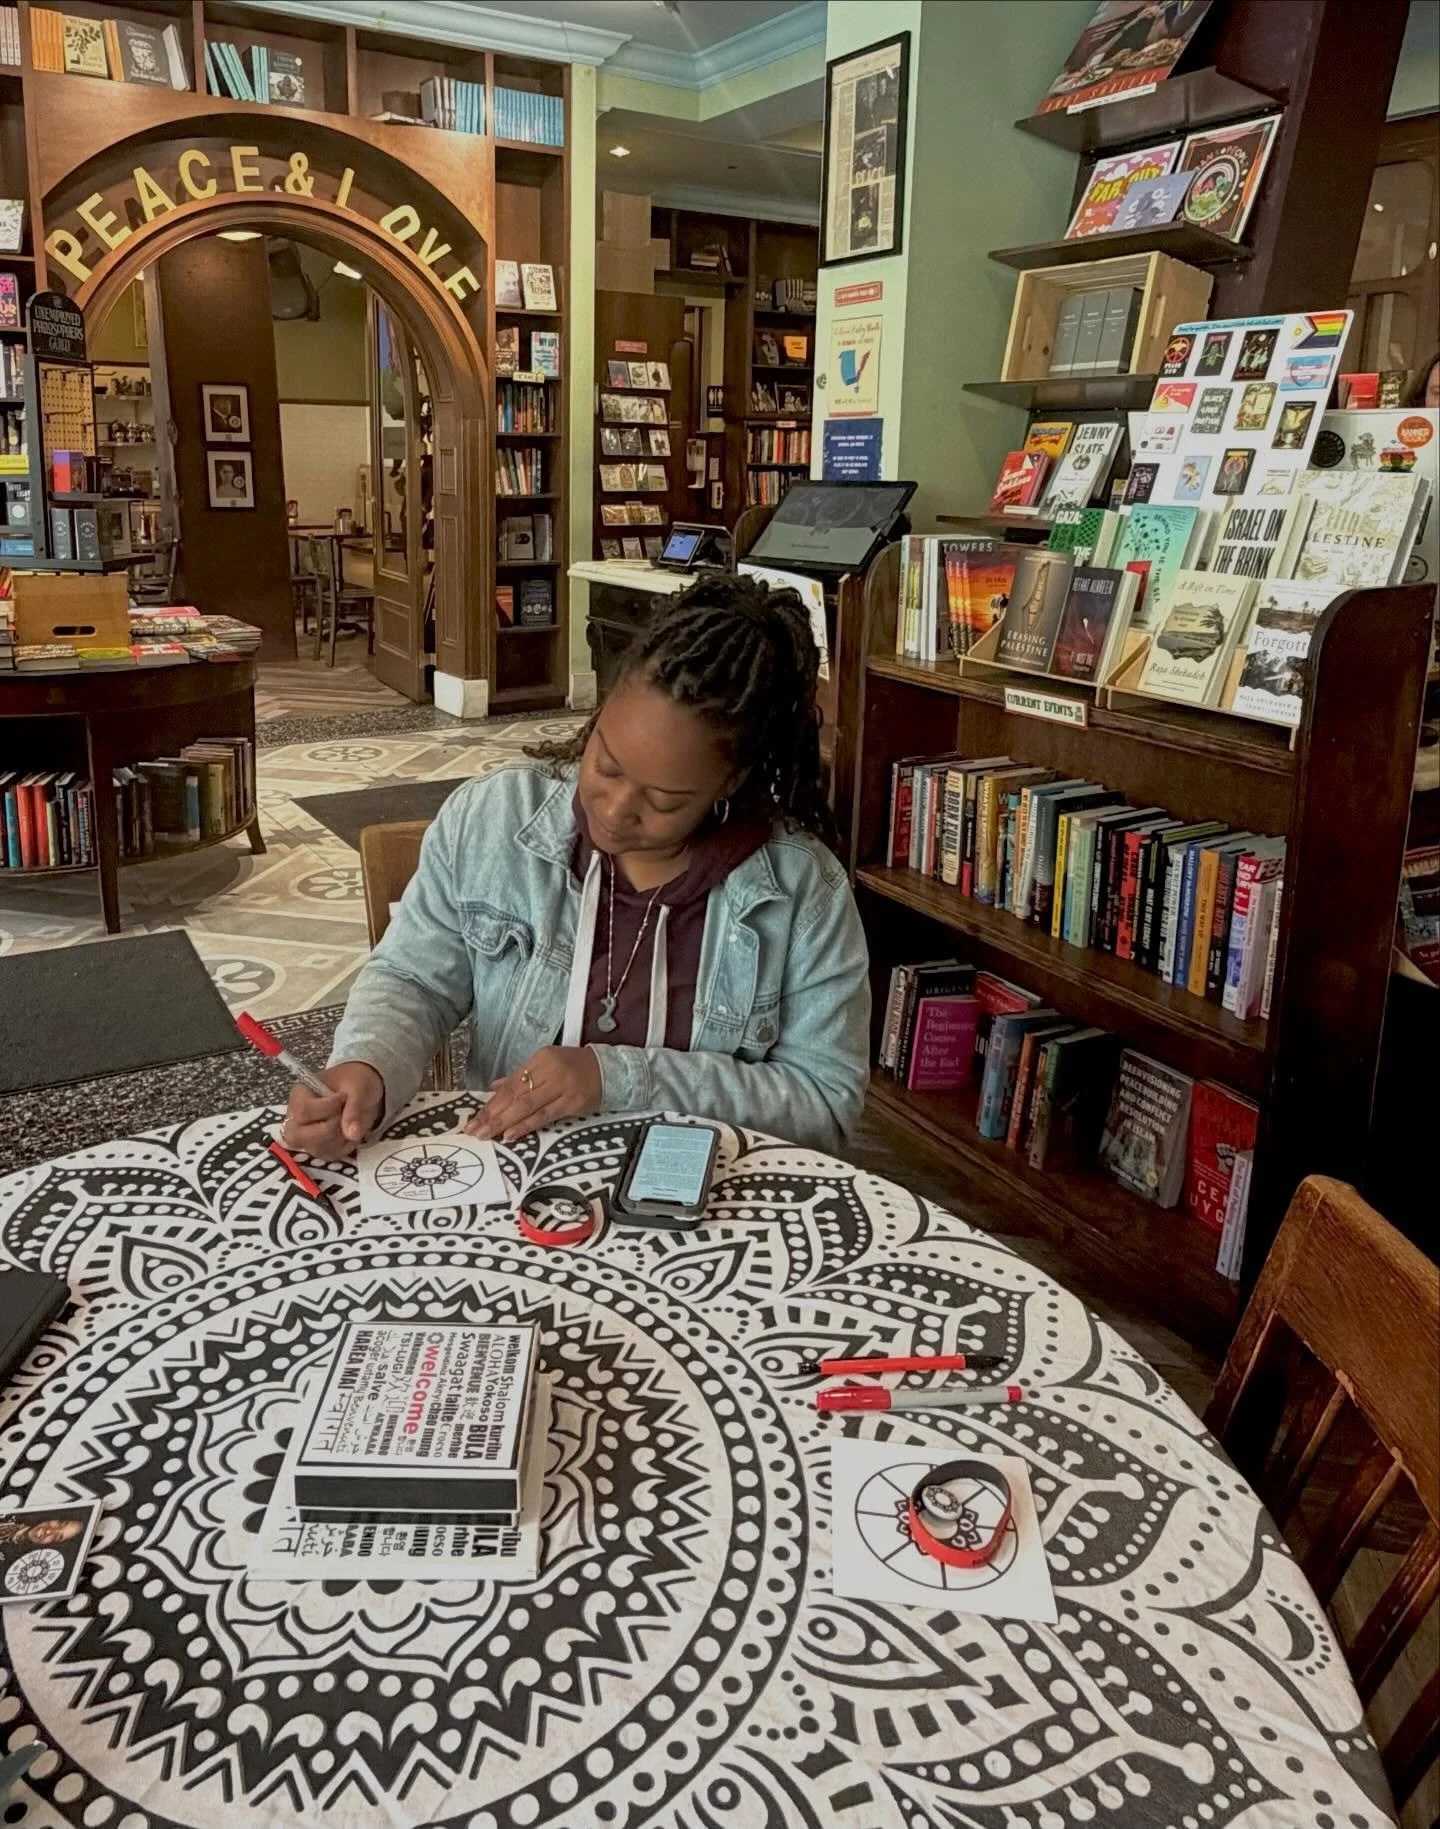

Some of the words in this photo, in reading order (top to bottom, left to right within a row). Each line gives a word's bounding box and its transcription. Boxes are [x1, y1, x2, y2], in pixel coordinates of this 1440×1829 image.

[44, 145, 264, 283] PEACE
[285, 151, 314, 199] &
[33, 318, 84, 341] PHILOSOPHERS
[34, 305, 81, 325] UNEMPLOYED
[1074, 443, 1105, 455] SLATE
[1076, 426, 1114, 440] JENNY
[1223, 508, 1266, 541] ISRAEL
[1264, 508, 1287, 542] ON
[1305, 533, 1386, 549] LESTINE
[943, 542, 993, 554] TOWERS
[1213, 545, 1238, 573] THE
[1232, 547, 1276, 580] BRINK
[1000, 640, 1049, 657] PALESTINE
[1007, 630, 1047, 645] ERASING
[1007, 693, 1042, 710] CURRENT
[1043, 700, 1074, 717] EVENTS
[945, 790, 960, 820] BORN
[943, 821, 959, 856] EQUAL
[927, 1006, 947, 1017] The
[927, 1019, 976, 1031] Beginning
[922, 1044, 949, 1055] After
[924, 1032, 957, 1042] Comes
[920, 1057, 936, 1067] the
[940, 1057, 959, 1067] End
[1122, 1060, 1181, 1099] REENVISIONING
[1120, 1073, 1179, 1113] PEACEBUILDING
[1120, 1087, 1136, 1102] AND
[1137, 1099, 1172, 1123] CONFLICT
[1120, 1101, 1167, 1136] RESOLUTION
[346, 1330, 374, 1365] HAREA
[367, 1330, 387, 1361] acoger
[391, 1331, 413, 1374] TSI-LUGI
[449, 1332, 476, 1391] Swaagat
[486, 1333, 505, 1378] ALOHA
[503, 1334, 521, 1374] welkom
[337, 1367, 361, 1390] MAI
[466, 1333, 491, 1394] BIENVENUE
[367, 1363, 388, 1401] salve
[403, 1344, 440, 1435] welcome
[479, 1377, 499, 1422] Yokoso
[493, 1375, 514, 1423] Shalom
[377, 1414, 399, 1456] BIENVENIDO
[415, 1428, 435, 1458] mung
[463, 1424, 489, 1459] BULA
[484, 1424, 505, 1460] kuribu
